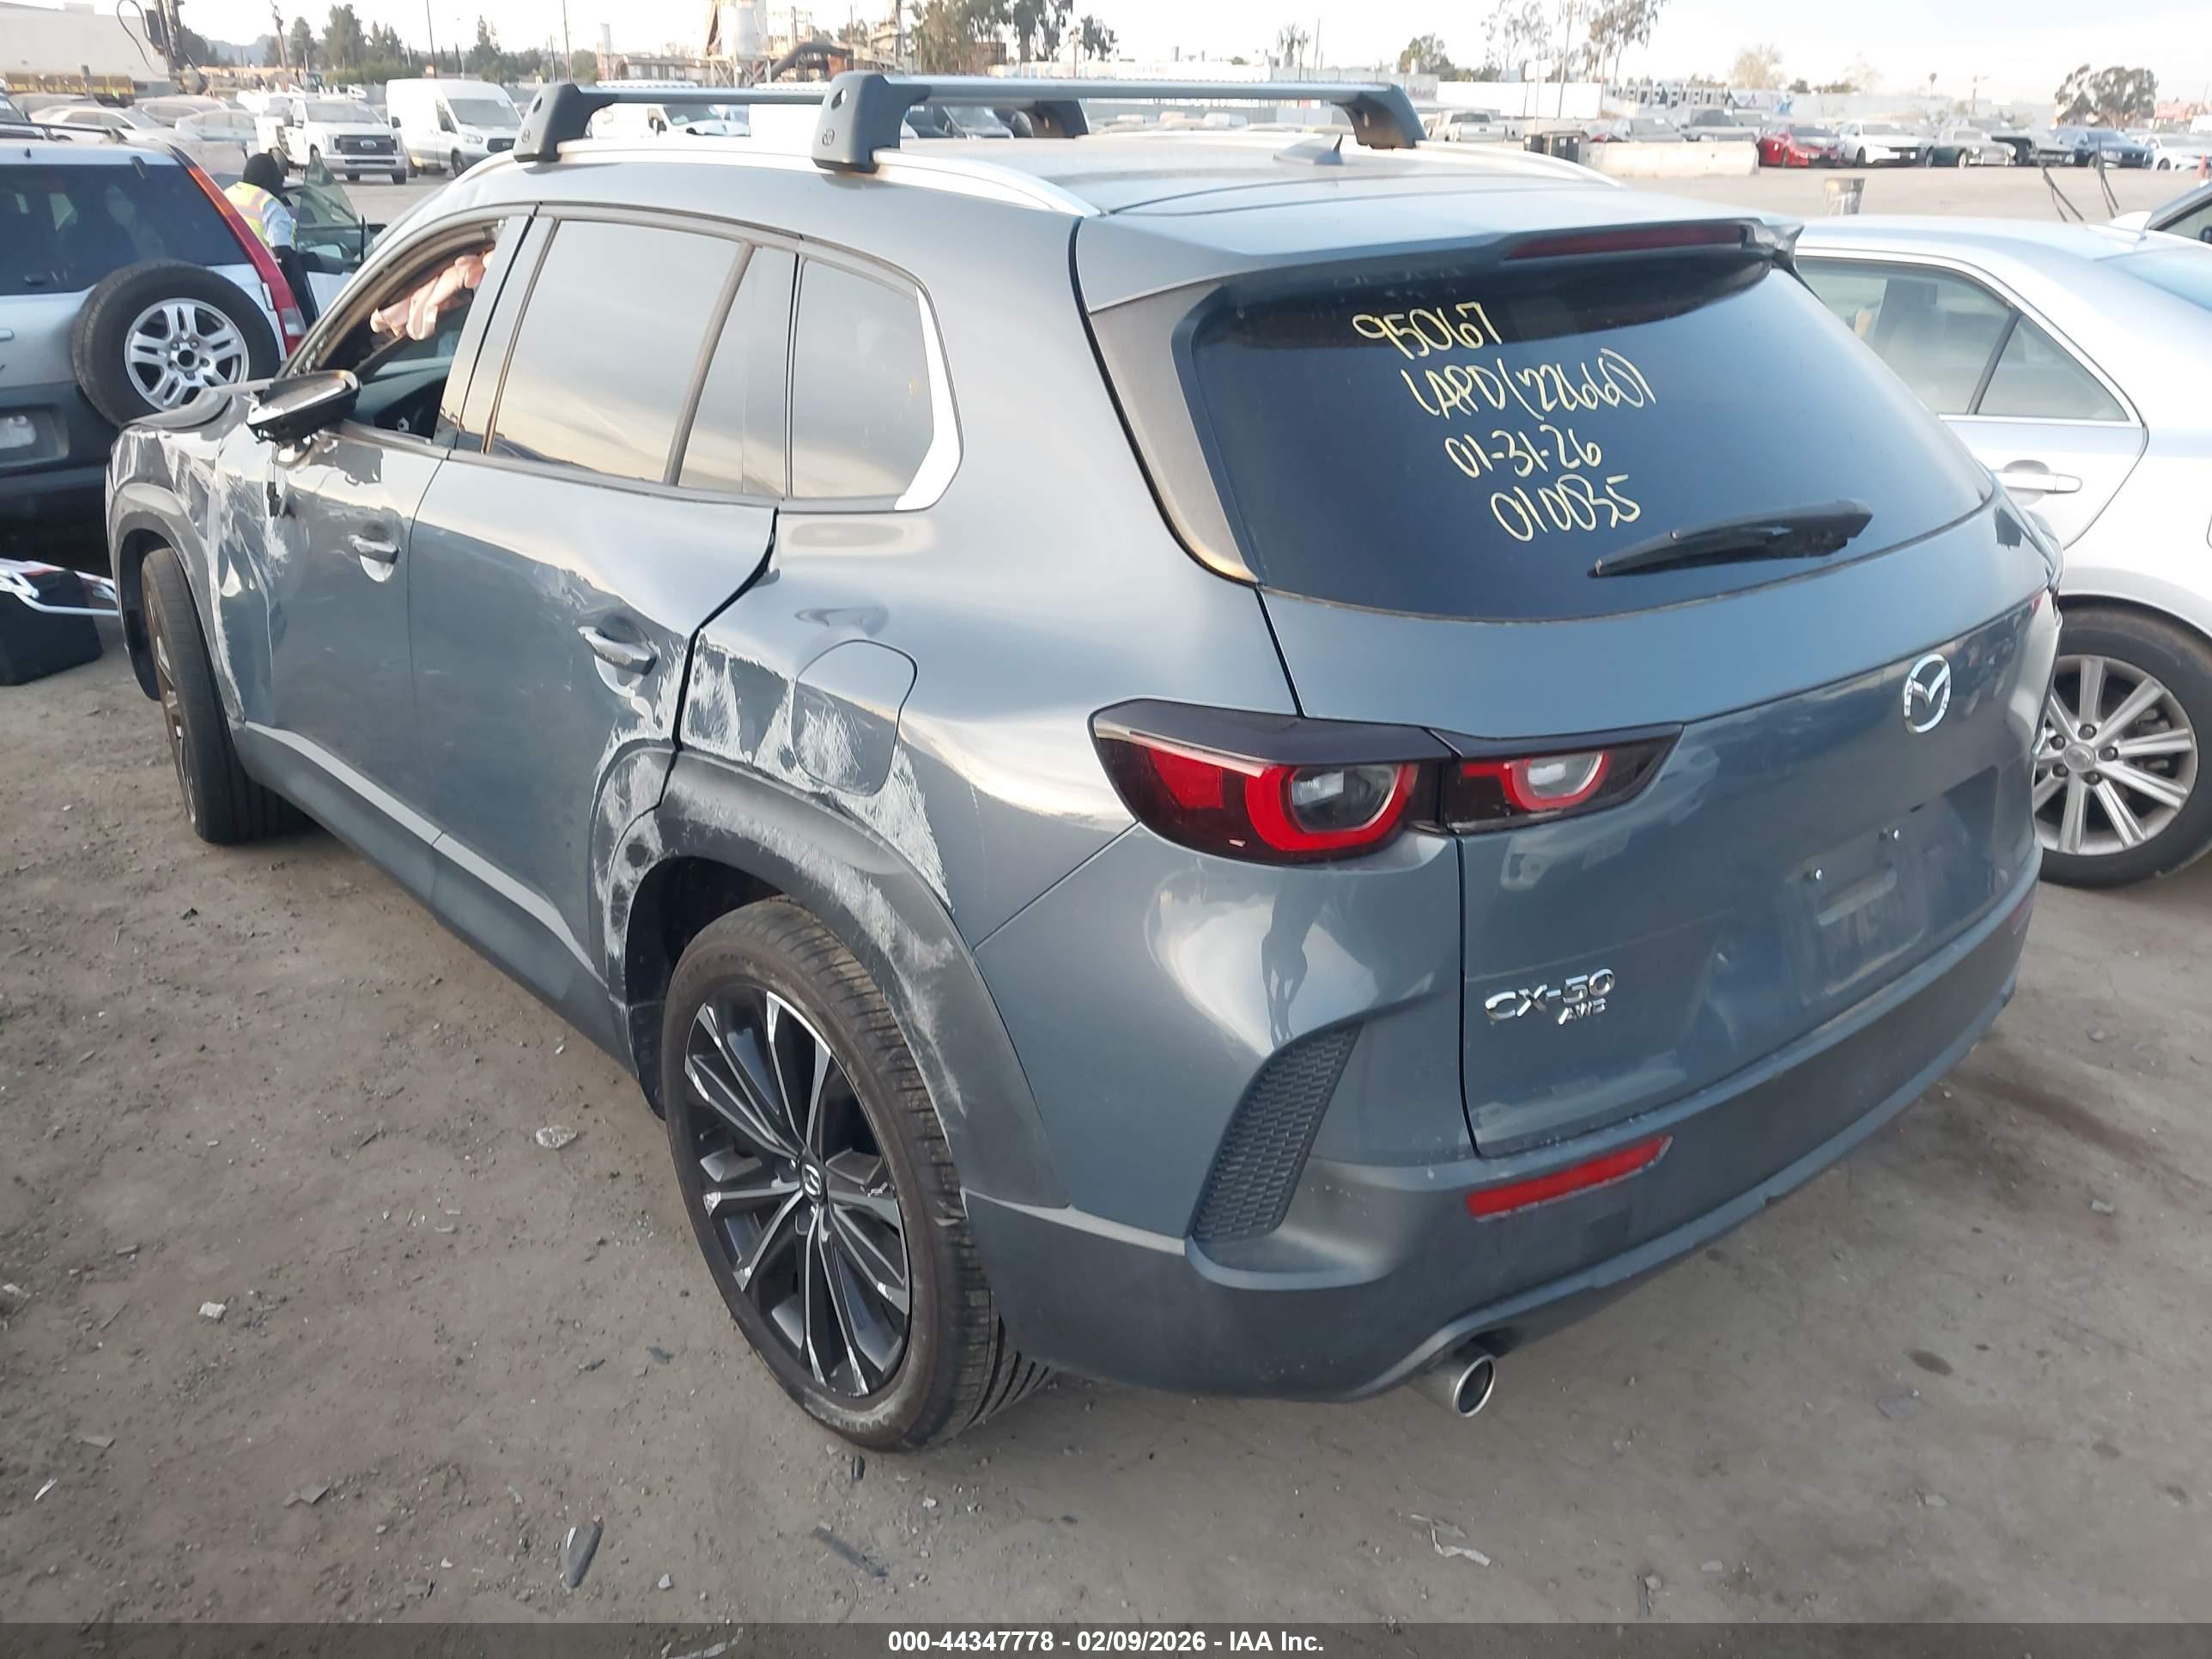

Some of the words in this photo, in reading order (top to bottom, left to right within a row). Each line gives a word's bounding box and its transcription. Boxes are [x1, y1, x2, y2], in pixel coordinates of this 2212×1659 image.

[1352, 301, 1502, 360] 95067
[1444, 424, 1602, 478] 01-31-26
[1485, 969, 1615, 1021] CX-50
